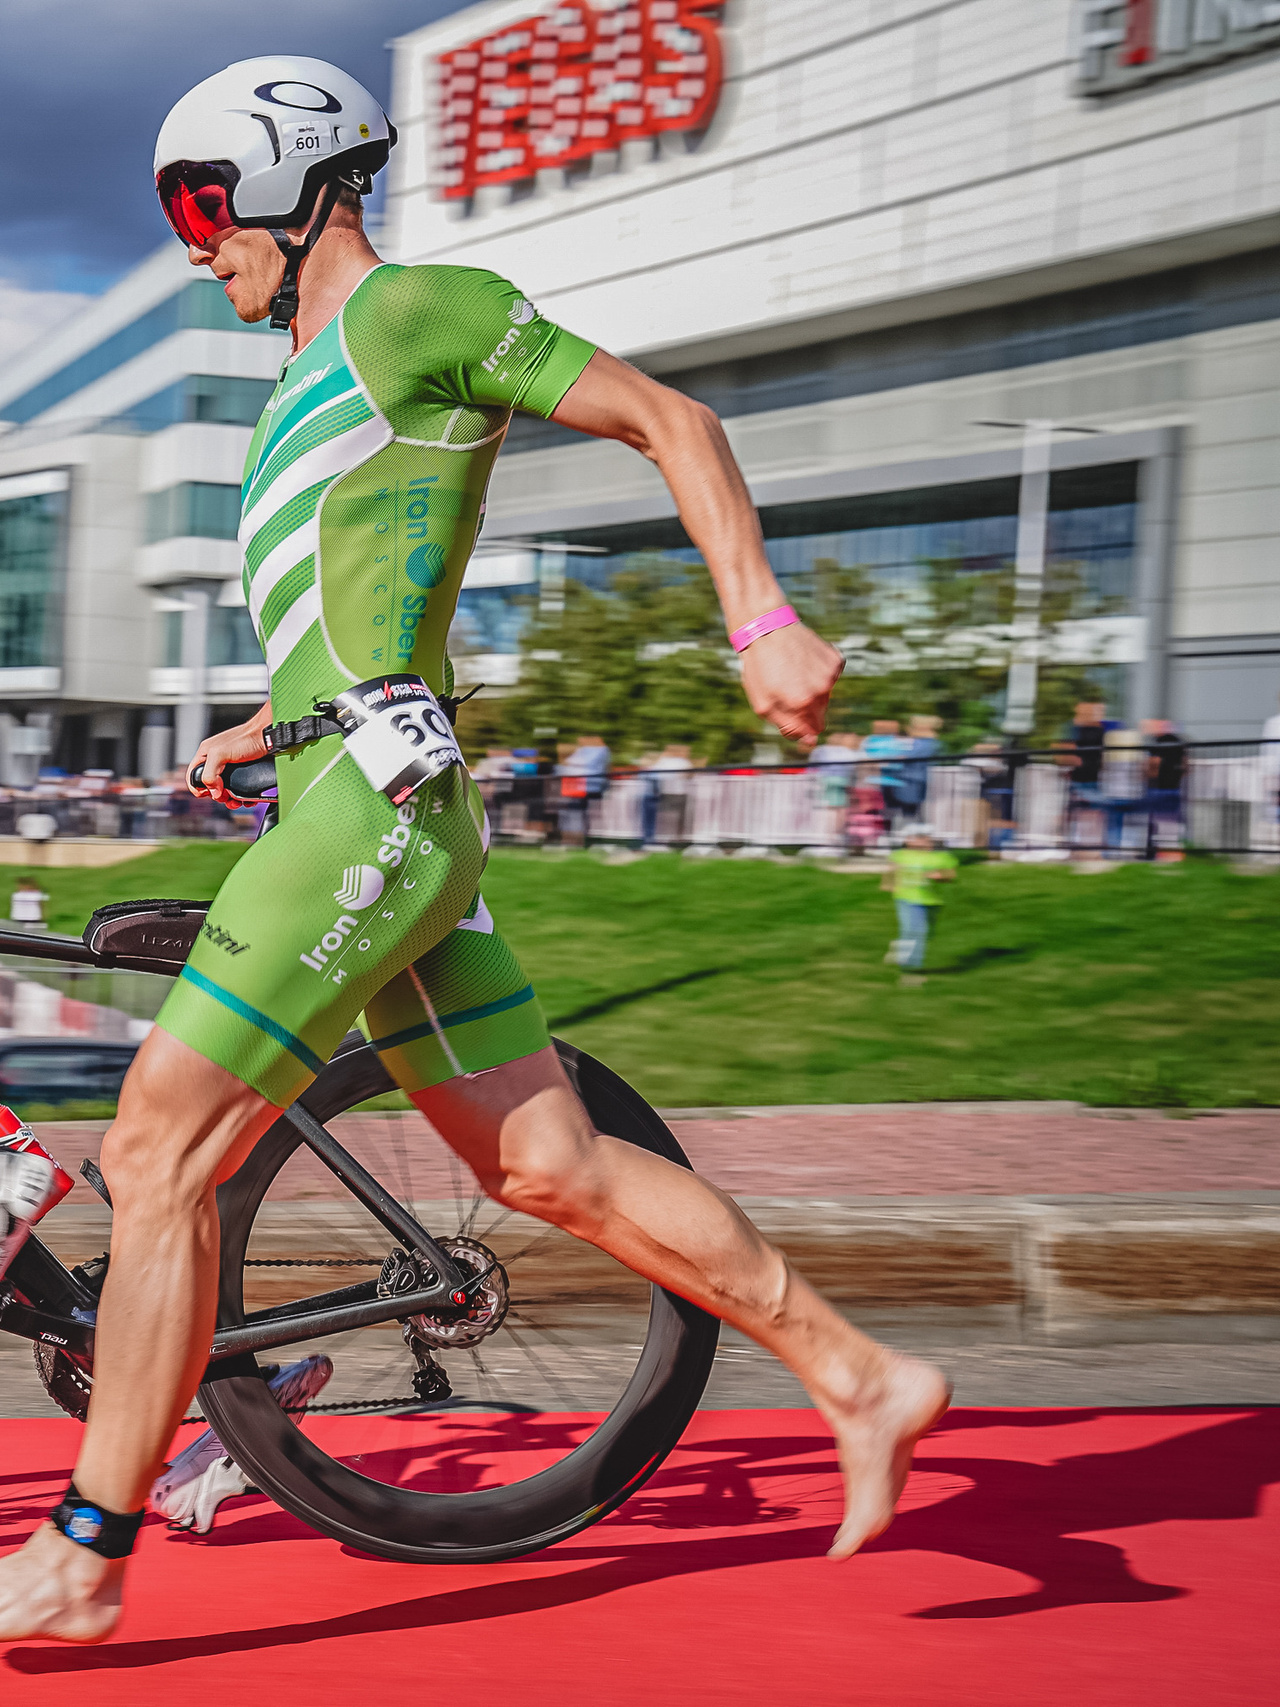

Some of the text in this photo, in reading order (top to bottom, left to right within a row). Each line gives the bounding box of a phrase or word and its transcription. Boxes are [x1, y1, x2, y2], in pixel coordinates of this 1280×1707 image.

[296, 135, 320, 150] 601
[482, 327, 521, 373] Iron
[406, 475, 439, 540] Iron
[397, 593, 429, 664] Sber
[299, 914, 359, 972] Iron
